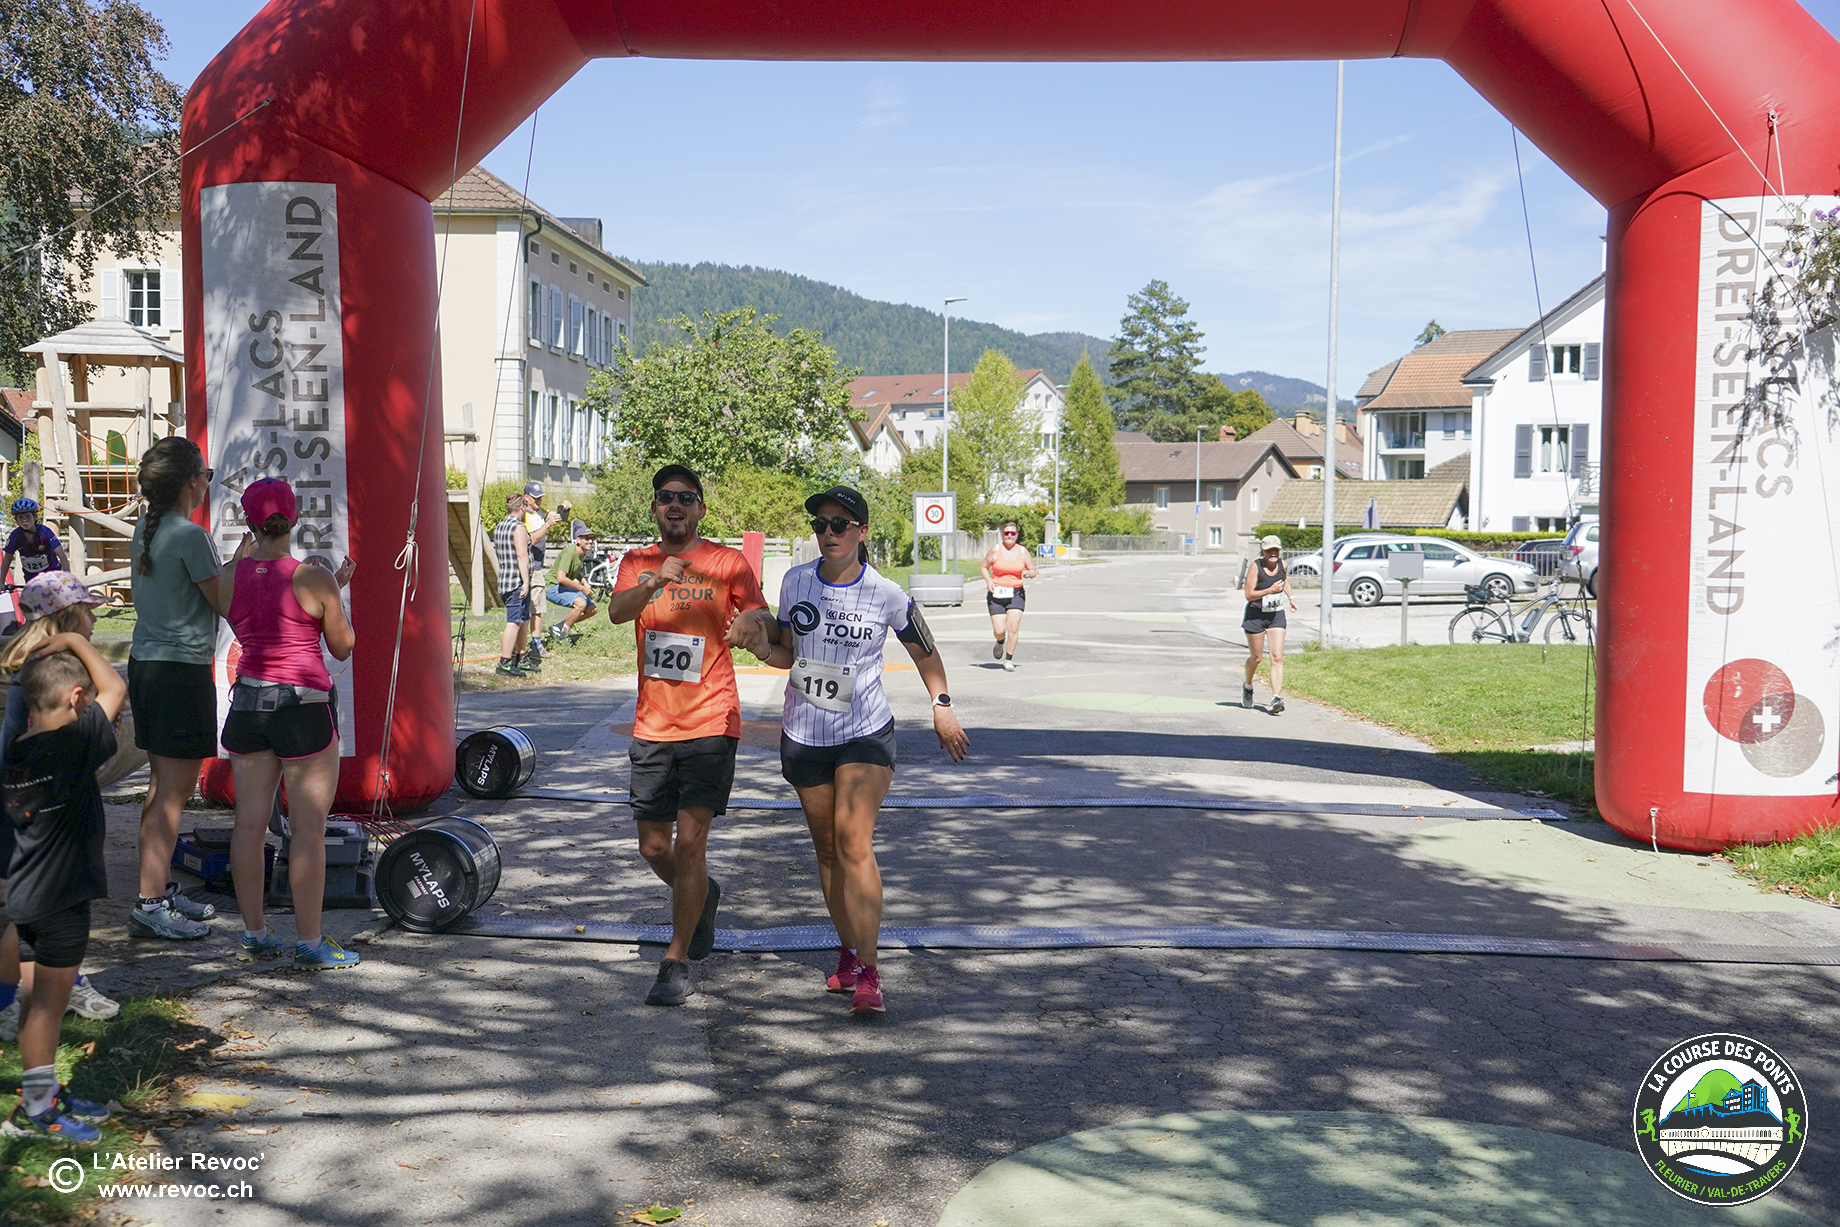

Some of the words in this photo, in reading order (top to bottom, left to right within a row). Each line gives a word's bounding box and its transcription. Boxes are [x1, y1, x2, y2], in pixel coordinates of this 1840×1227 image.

[1706, 212, 1757, 616] DREI-SEEN-LAND
[930, 510, 939, 518] 30
[682, 575, 704, 585] BCN
[668, 588, 714, 601] TOUR
[669, 601, 692, 612] 2025
[839, 612, 863, 622] BCN
[824, 623, 873, 641] TOUR
[843, 640, 861, 648] 2026
[652, 648, 692, 671] 120
[802, 676, 839, 700] 119
[477, 744, 498, 786] MYLAPS
[410, 851, 451, 909] MYLAPS
